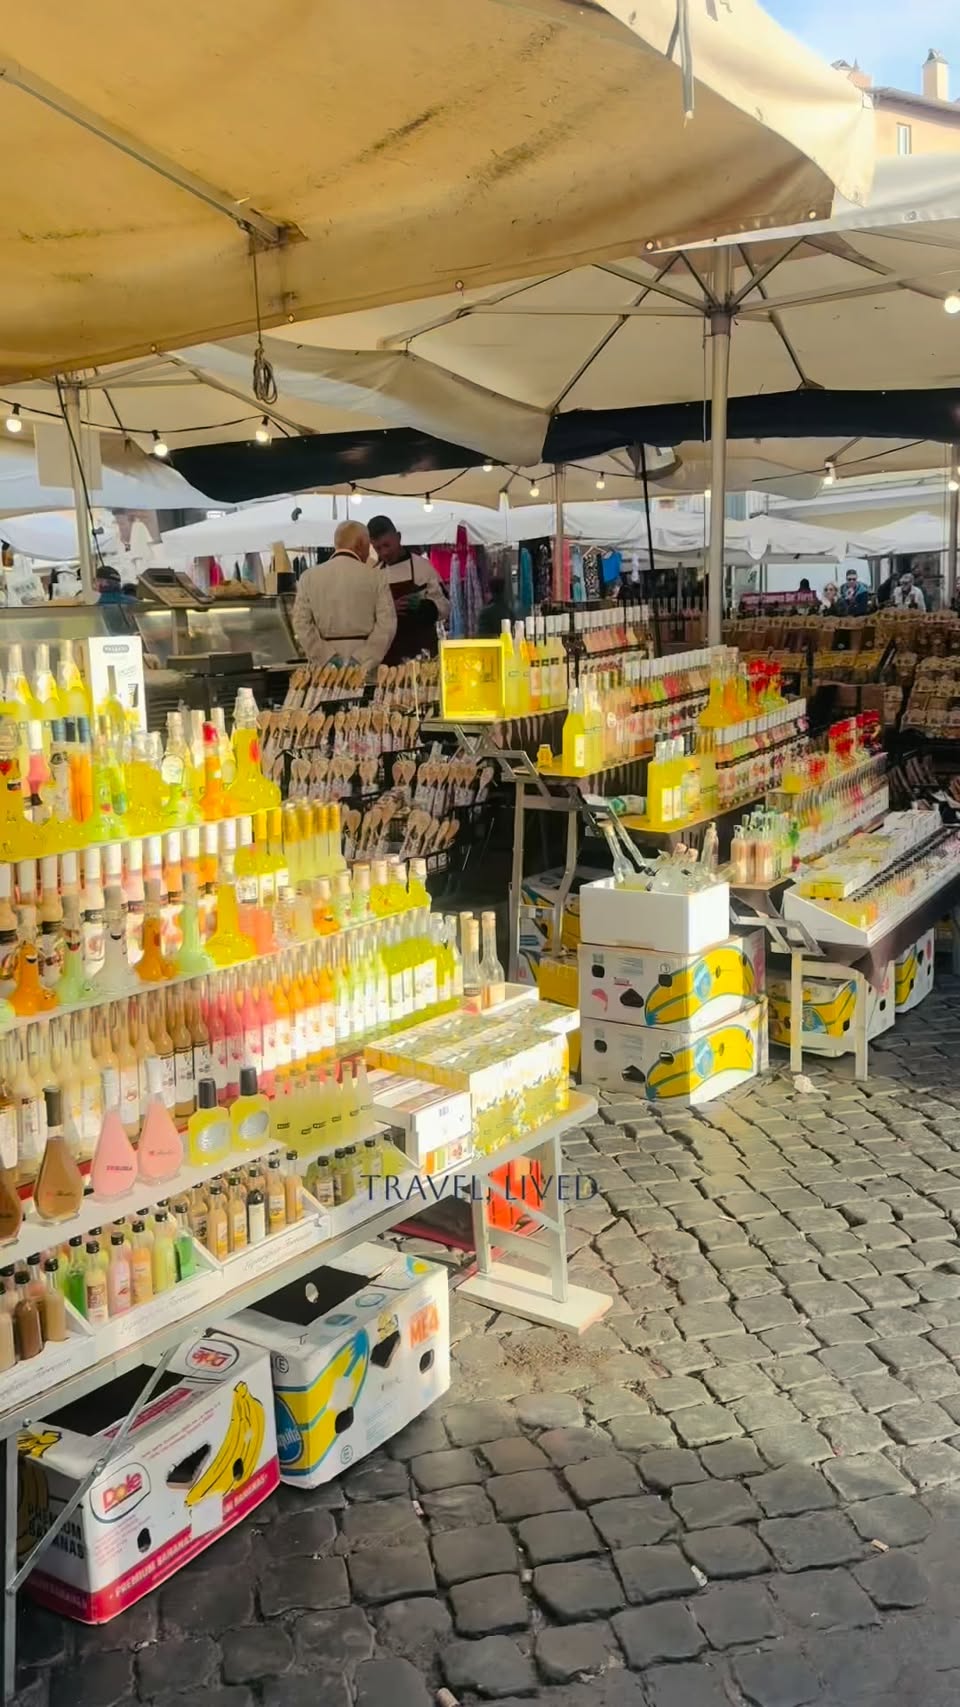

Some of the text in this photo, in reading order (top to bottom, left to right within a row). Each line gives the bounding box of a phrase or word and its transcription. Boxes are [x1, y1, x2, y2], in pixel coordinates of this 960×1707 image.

[192, 1348, 231, 1367] Dole
[102, 1472, 142, 1511] Dole
[115, 1560, 156, 1598] PREMIUM
